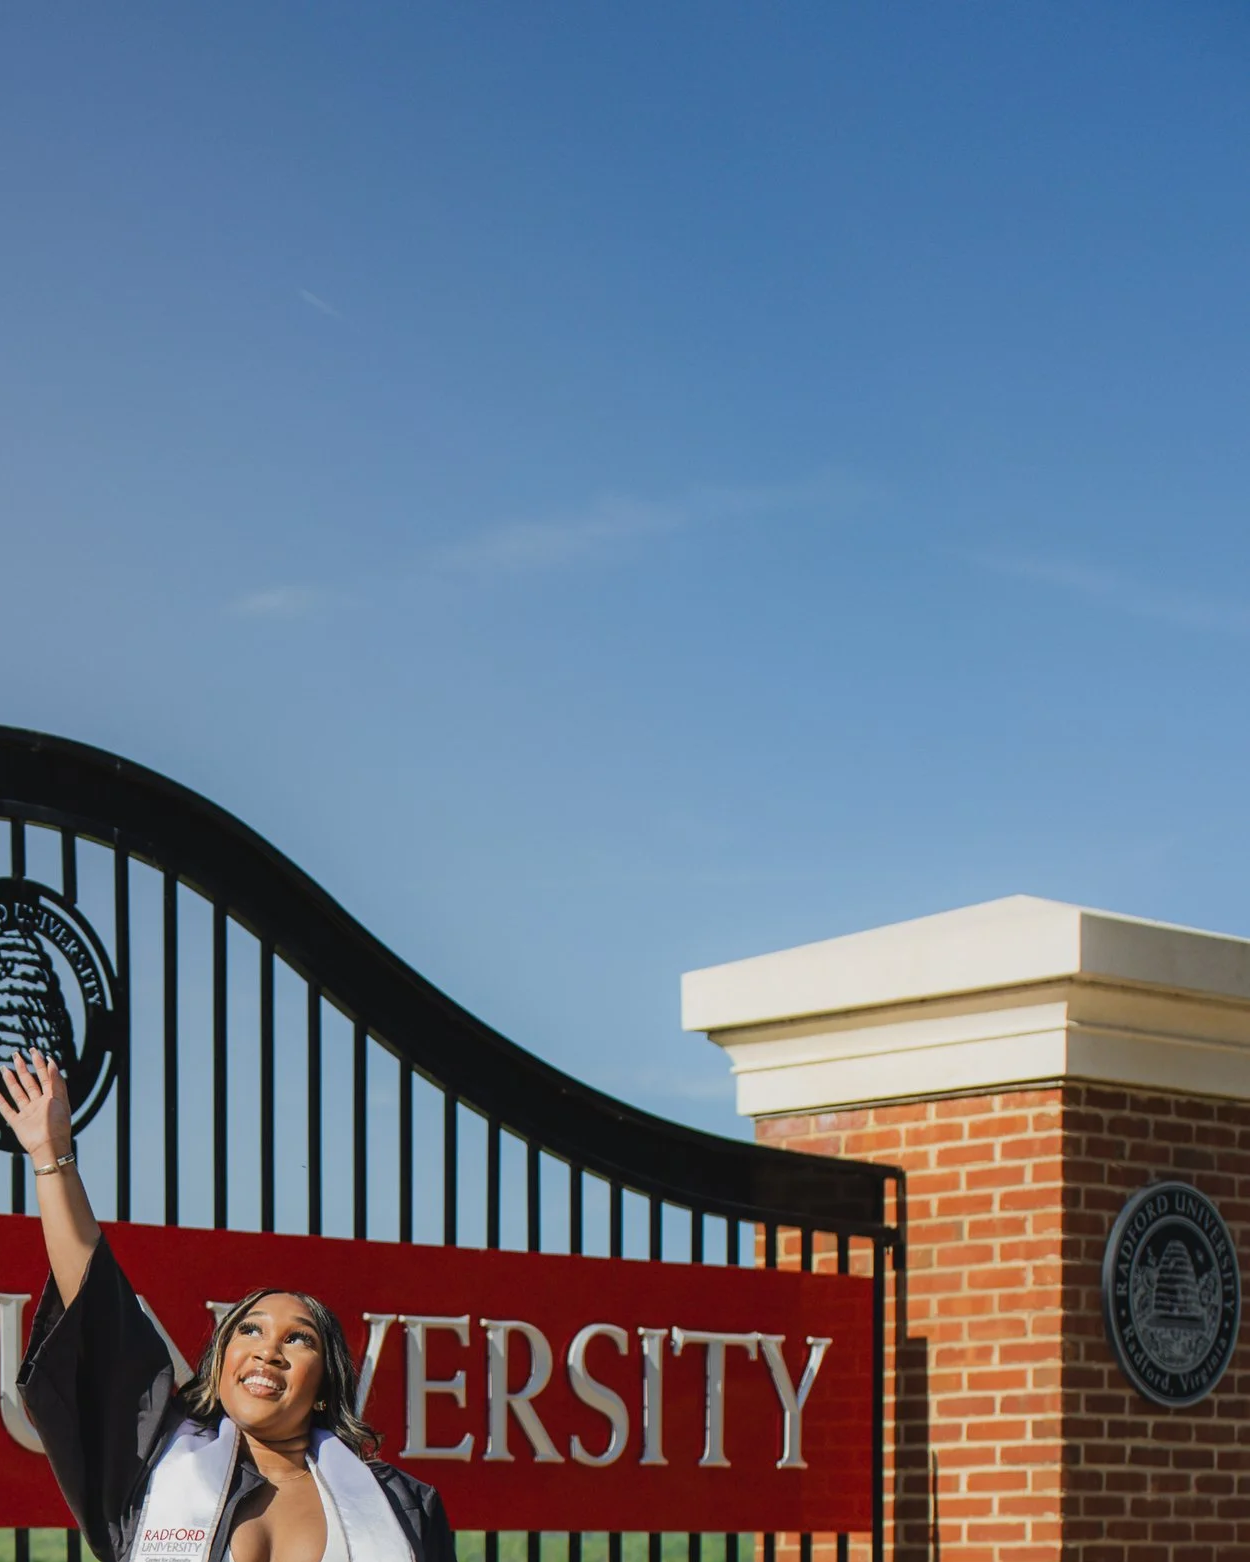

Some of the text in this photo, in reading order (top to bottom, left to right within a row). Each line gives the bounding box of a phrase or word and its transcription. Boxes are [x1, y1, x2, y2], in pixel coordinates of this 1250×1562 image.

[1116, 1191, 1235, 1313] RADFORD UNIVERSITY
[1179, 1337, 1228, 1393] Virginia
[141, 1542, 202, 1553] UNIVERSITY
[144, 1528, 205, 1541] RADFORD
